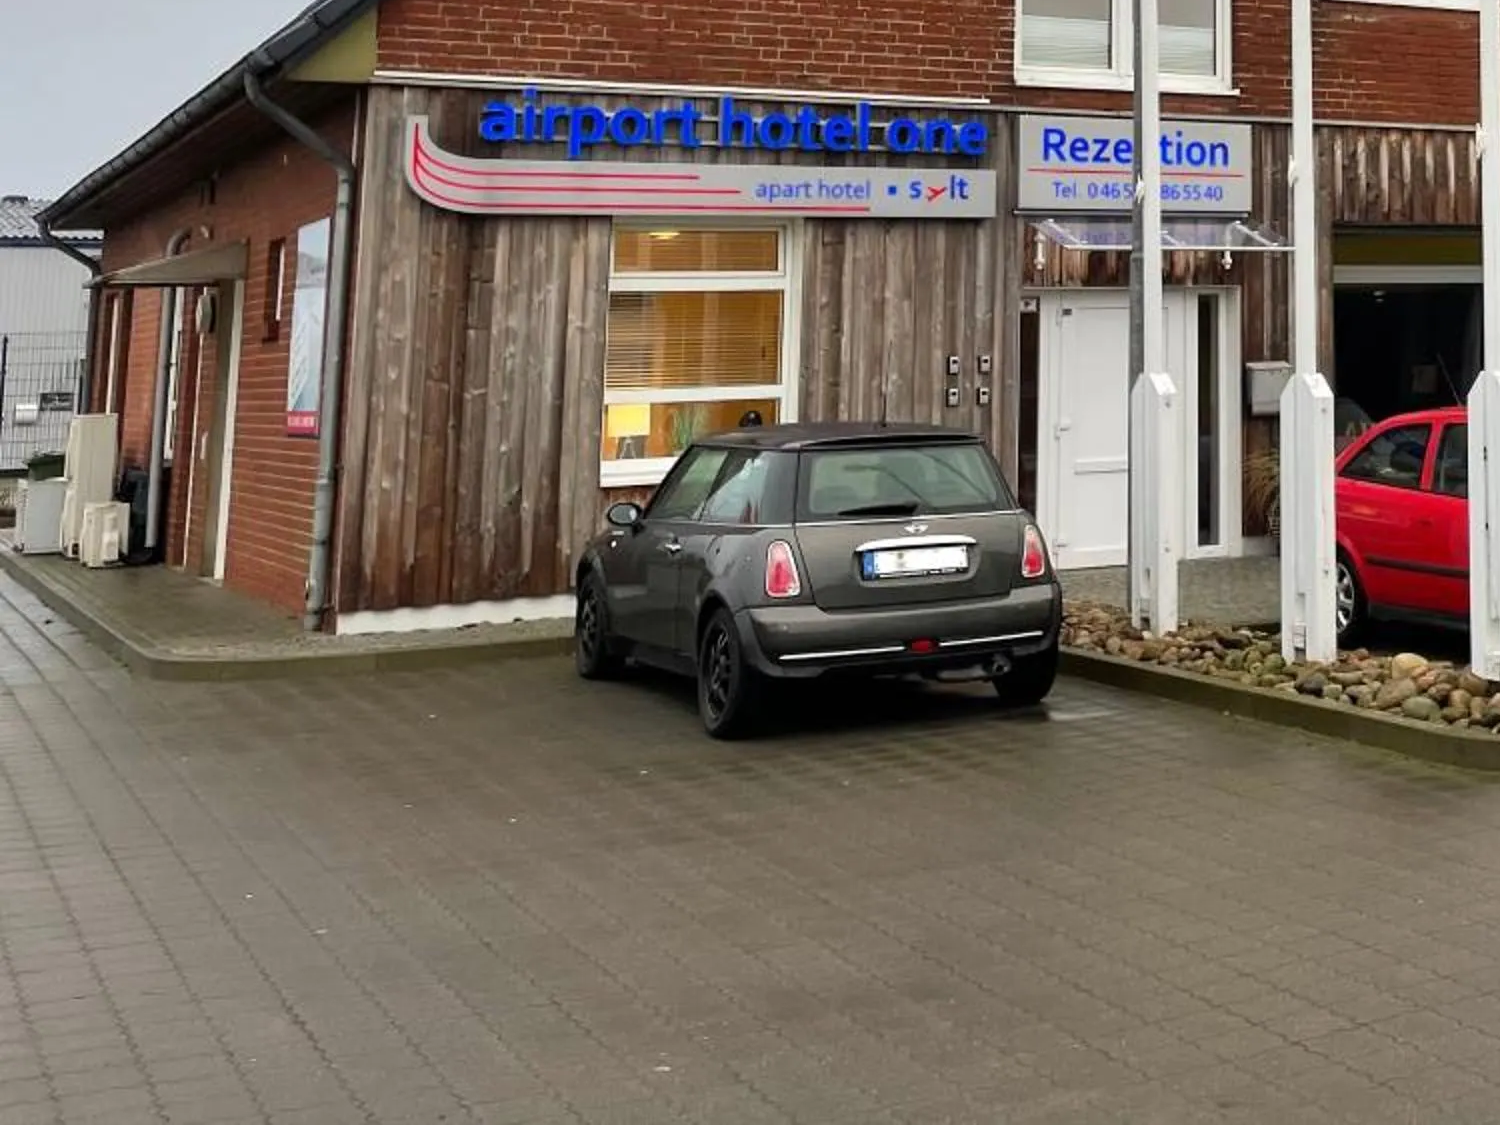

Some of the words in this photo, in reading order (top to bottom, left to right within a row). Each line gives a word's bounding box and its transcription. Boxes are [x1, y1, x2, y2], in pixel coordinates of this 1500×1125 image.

[480, 84, 701, 160] airport
[719, 94, 870, 153] hotel
[886, 115, 989, 156] one
[1042, 127, 1229, 167] Rezetion
[755, 180, 813, 202] apart
[818, 179, 871, 199] hotel
[908, 175, 970, 202] sylt
